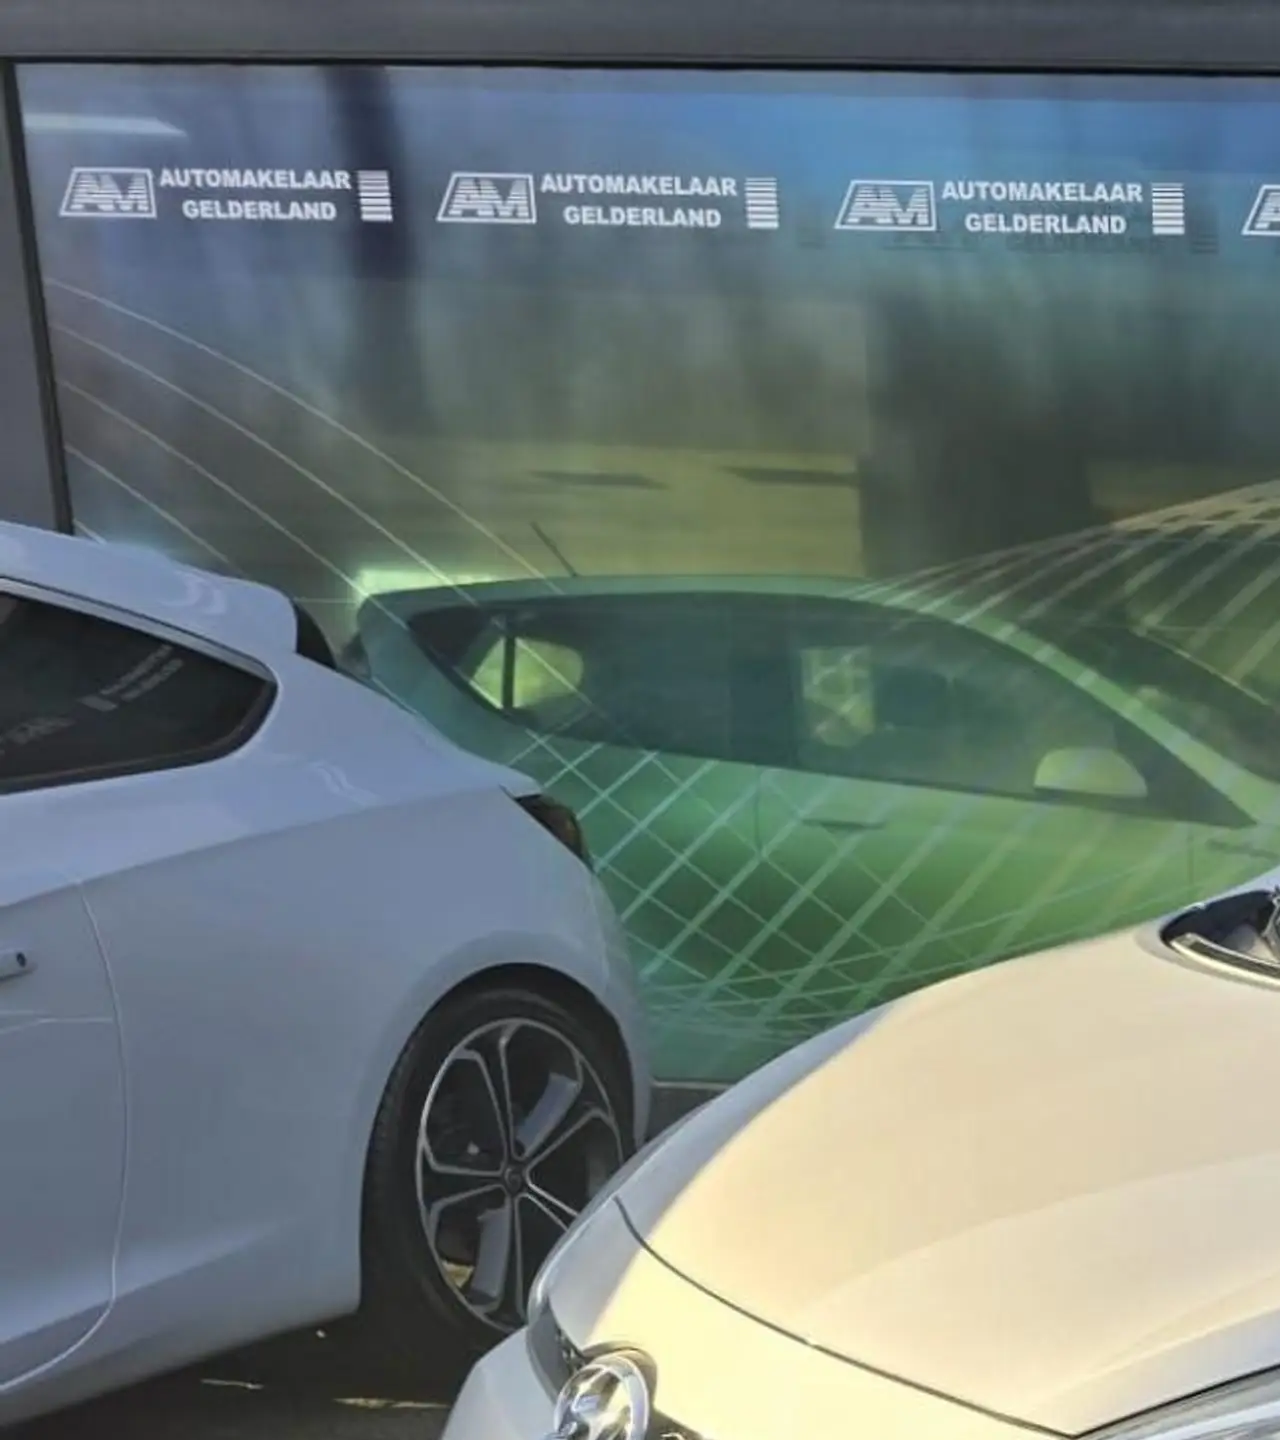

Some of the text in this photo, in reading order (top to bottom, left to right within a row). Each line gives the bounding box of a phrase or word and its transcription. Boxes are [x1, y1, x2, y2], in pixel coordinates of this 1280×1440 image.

[159, 168, 352, 190] AUTOMAKELAAR
[540, 173, 738, 197] AUTOMAKELAAR
[69, 173, 150, 212] AM
[447, 177, 532, 218] AM
[941, 180, 1143, 203] AUTOMAKELAAR
[182, 200, 337, 222] GELDERLAND
[845, 183, 931, 226] AM
[563, 205, 723, 228] GELDERLAND
[964, 213, 1128, 236] GELDERLAND
